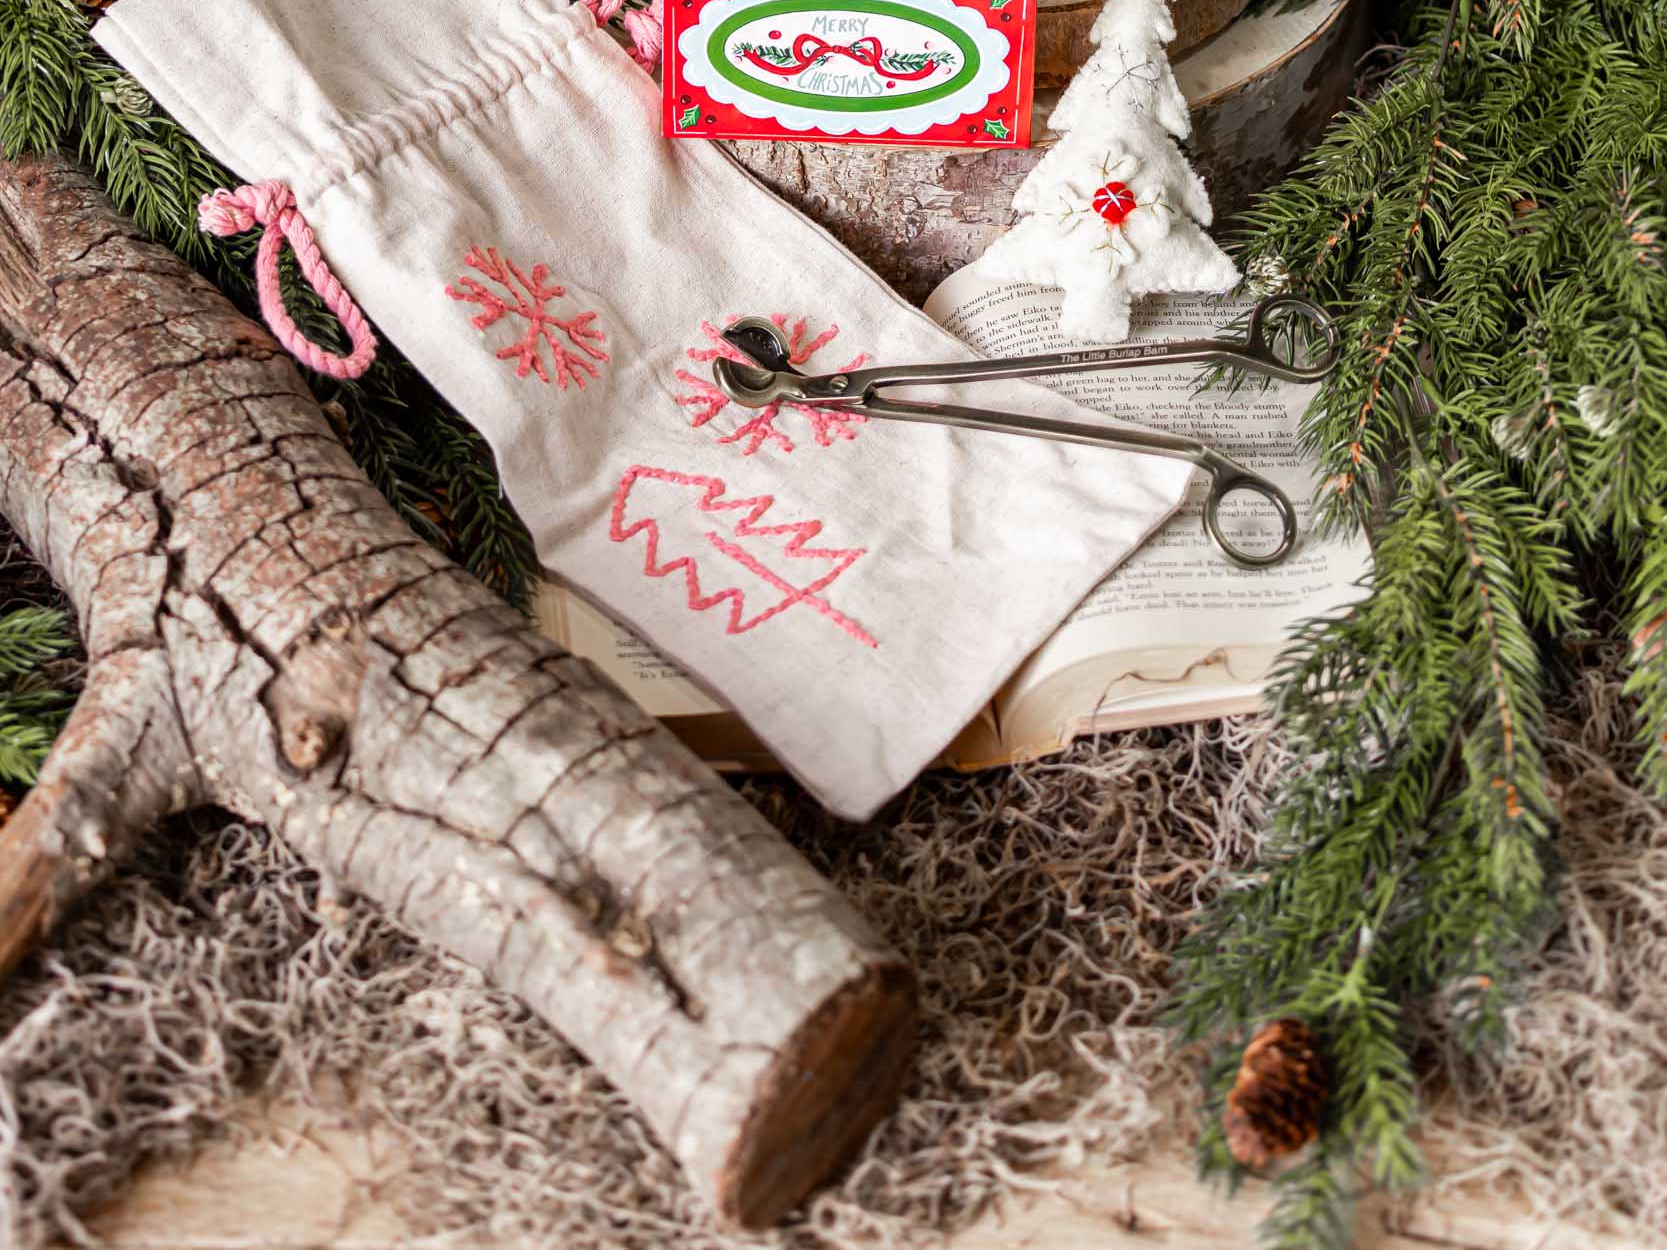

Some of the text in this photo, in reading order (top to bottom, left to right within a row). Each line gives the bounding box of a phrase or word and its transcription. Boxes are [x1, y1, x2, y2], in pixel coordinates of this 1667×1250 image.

[812, 14, 868, 37] MERRY
[942, 307, 960, 326] muel
[962, 286, 1001, 309] sounded
[959, 305, 985, 323] buggy
[988, 292, 1014, 308] freed
[1016, 288, 1037, 299] him
[1040, 286, 1065, 294] from
[1201, 300, 1236, 308] behind
[986, 319, 998, 328] he
[1000, 312, 1019, 322] saw
[1023, 305, 1047, 316] Eiko
[976, 335, 986, 344] to
[988, 327, 1003, 338] the
[1006, 314, 1054, 330] sidewalk.
[982, 332, 1016, 351] woman
[1020, 325, 1039, 336] had
[994, 334, 1044, 353] Sherman's
[1043, 342, 1078, 350] blood,
[1061, 354, 1080, 364] The
[1082, 352, 1105, 361] Little
[1109, 348, 1141, 360] Burlap
[1066, 378, 1094, 387] green
[1097, 376, 1116, 385] bag
[1131, 374, 1150, 382] her,
[1153, 373, 1172, 382] and
[1174, 373, 1191, 381] she
[1063, 387, 1078, 395] nd
[1083, 385, 1116, 394] began
[1135, 383, 1163, 391] work
[1074, 396, 1115, 404] topped.
[1115, 403, 1142, 412] Eiko,
[1146, 402, 1191, 410] checking
[1195, 402, 1212, 410] the
[1214, 402, 1249, 411] bloody
[1226, 441, 1296, 449] grandmother,
